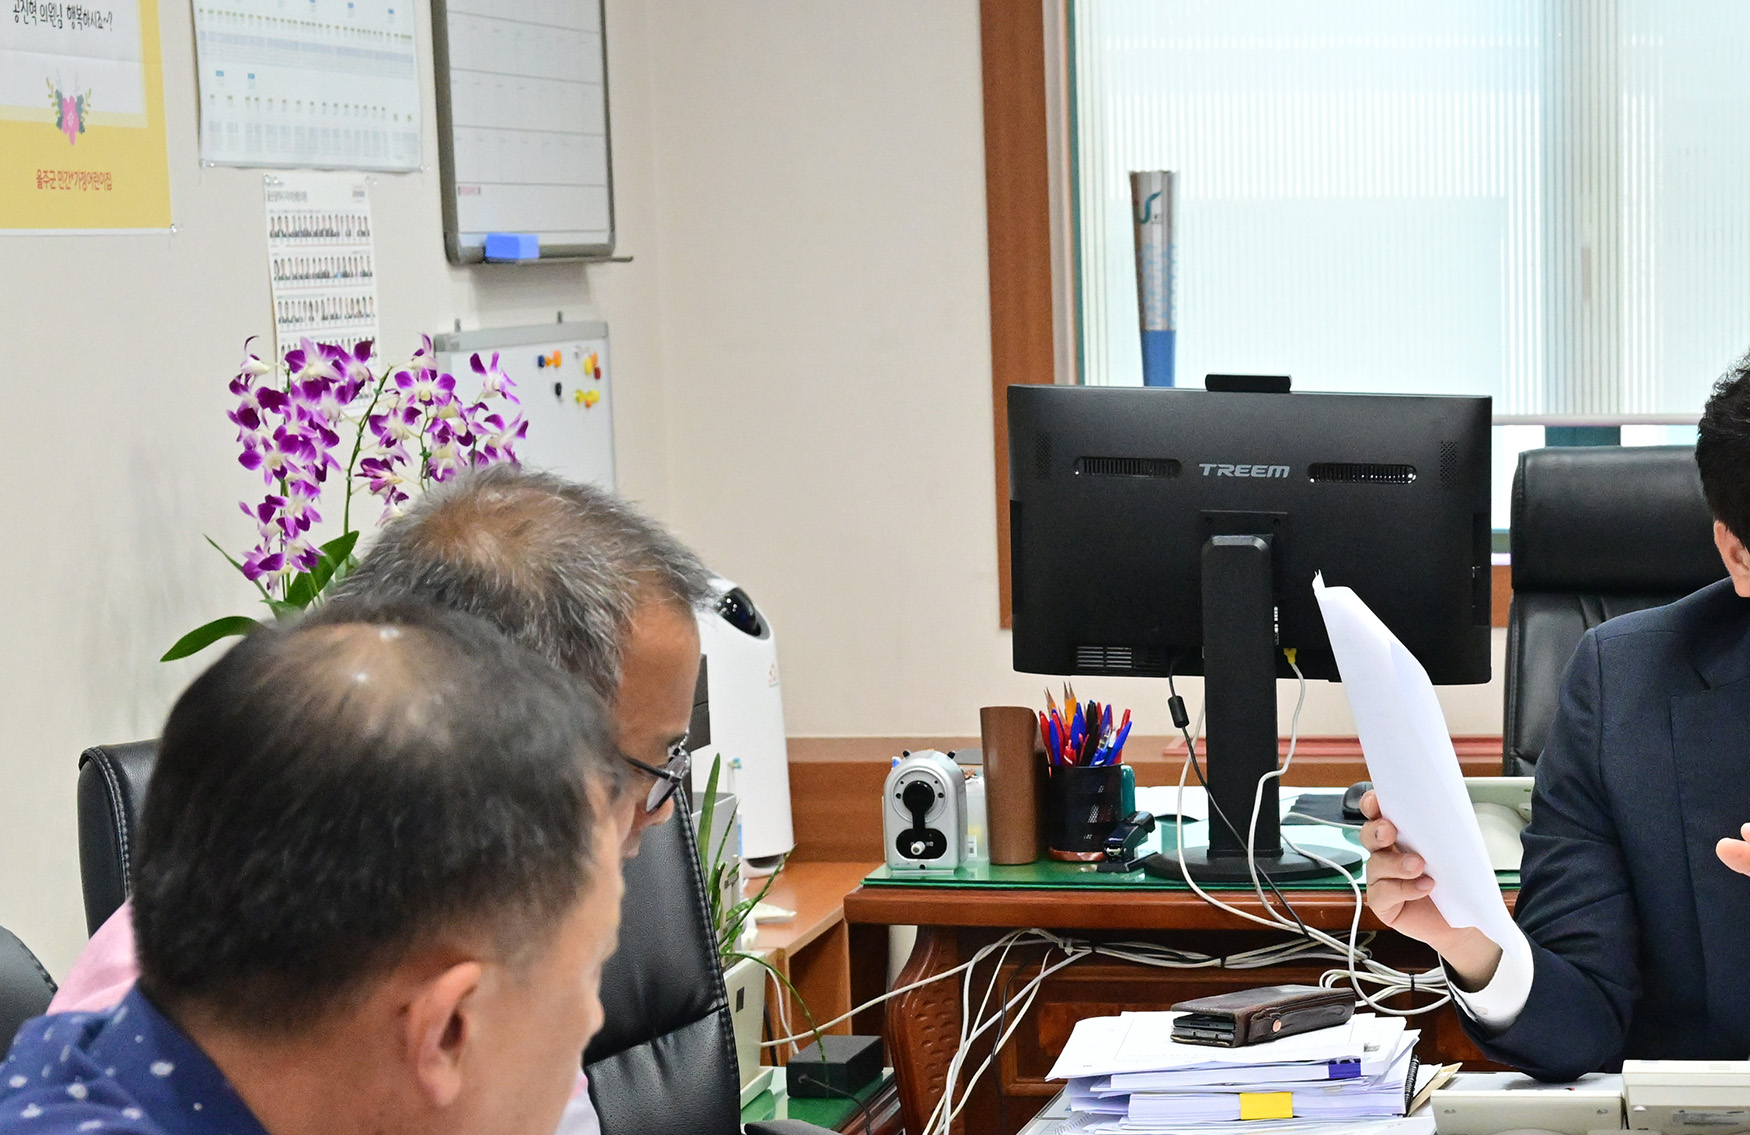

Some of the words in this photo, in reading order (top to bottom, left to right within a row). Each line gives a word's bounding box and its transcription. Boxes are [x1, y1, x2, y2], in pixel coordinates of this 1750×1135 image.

[39, 2, 63, 29] 의원님
[36, 169, 56, 190] 울주군
[1198, 463, 1291, 479] TREEM
